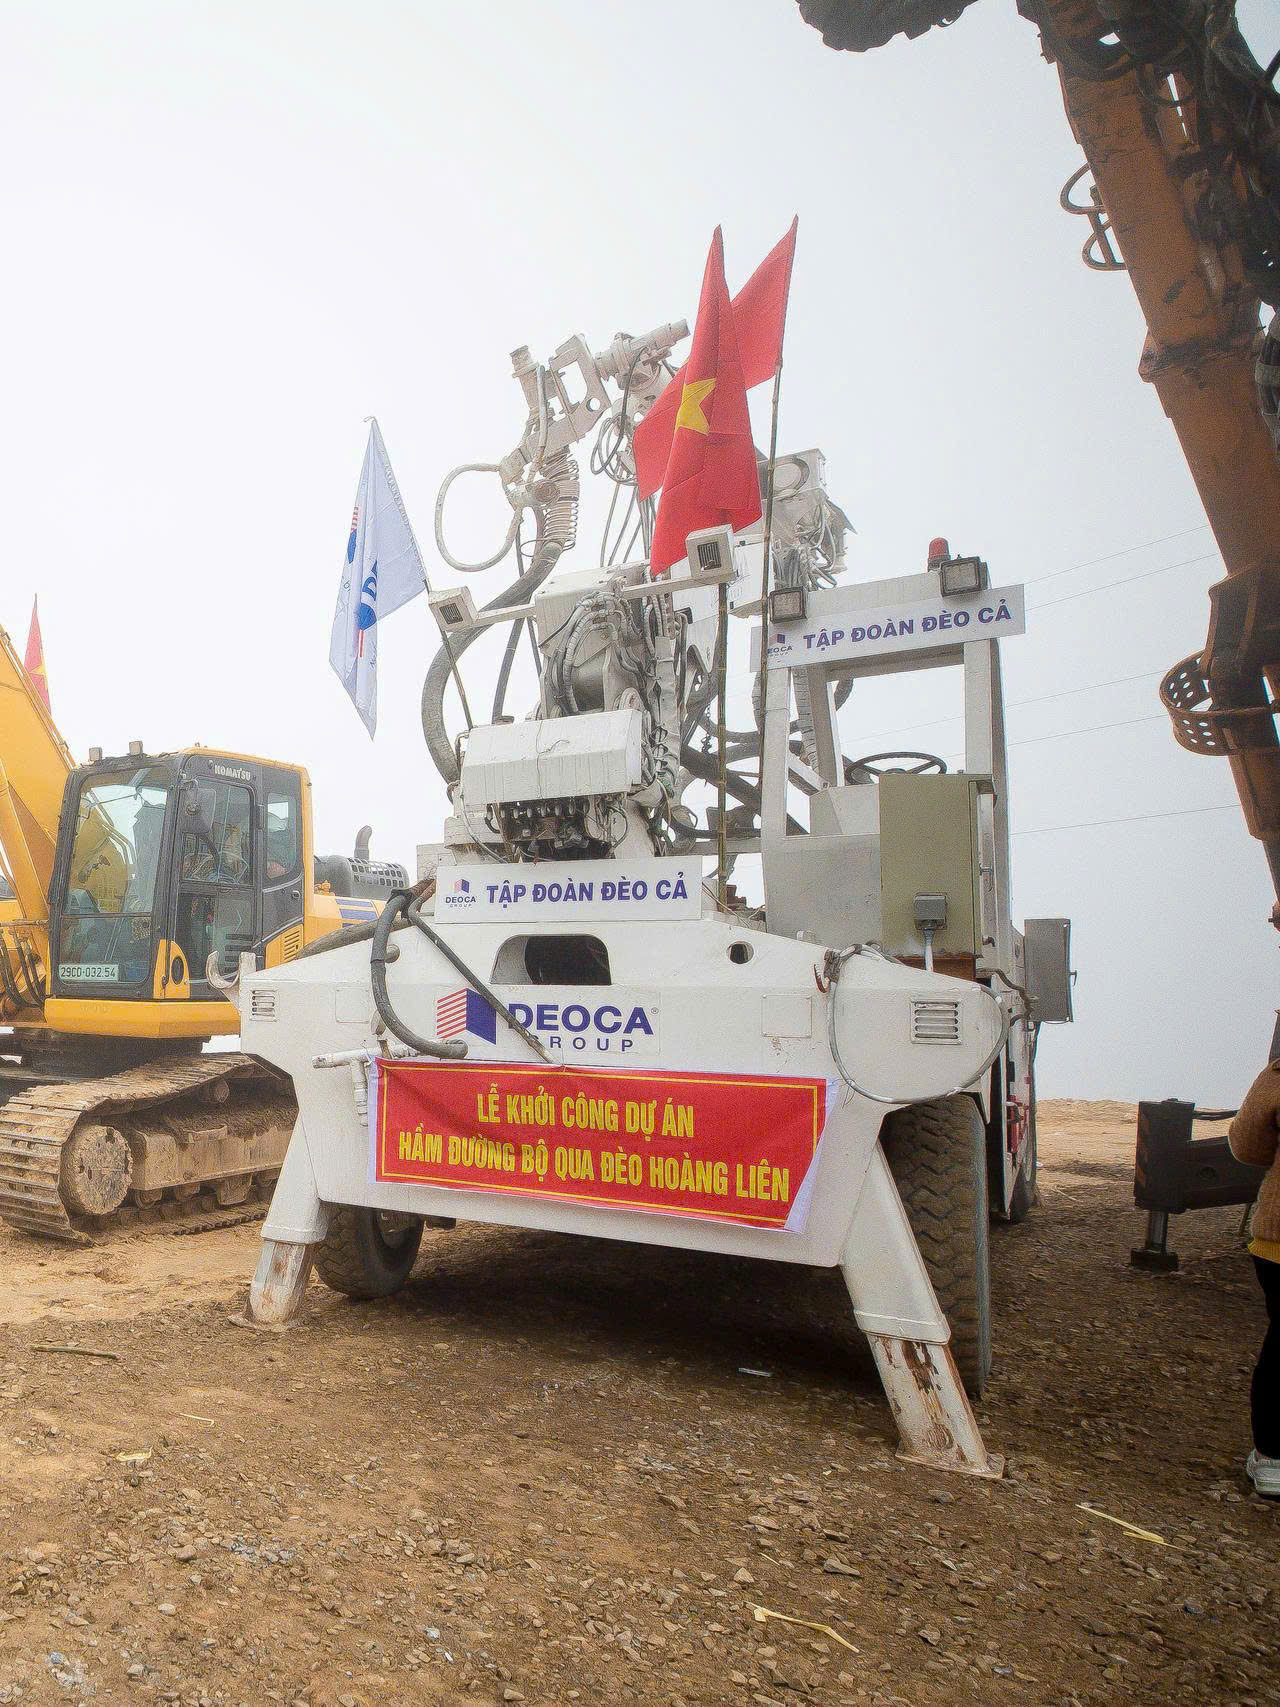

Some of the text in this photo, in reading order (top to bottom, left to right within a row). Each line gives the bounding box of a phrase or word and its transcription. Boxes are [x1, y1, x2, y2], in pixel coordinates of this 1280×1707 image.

[803, 599, 1011, 651] TẬP ĐOÀN ĐÈO CẢ
[767, 645, 793, 654] EOCA
[214, 764, 251, 781] KOMATSU
[445, 895, 476, 904] DEOCA
[486, 871, 688, 908] TẬP ĐOÀN ĐÈO CẢ
[508, 1003, 654, 1035] DEOCA
[534, 1034, 634, 1052] ROUP
[477, 1082, 694, 1138] LỄ KHỞI CÔNG DỰ ÁN
[398, 1122, 790, 1202] HẦM ĐƯỜNG BỘ QUA ĐÈO HOÀNG LIÊN
